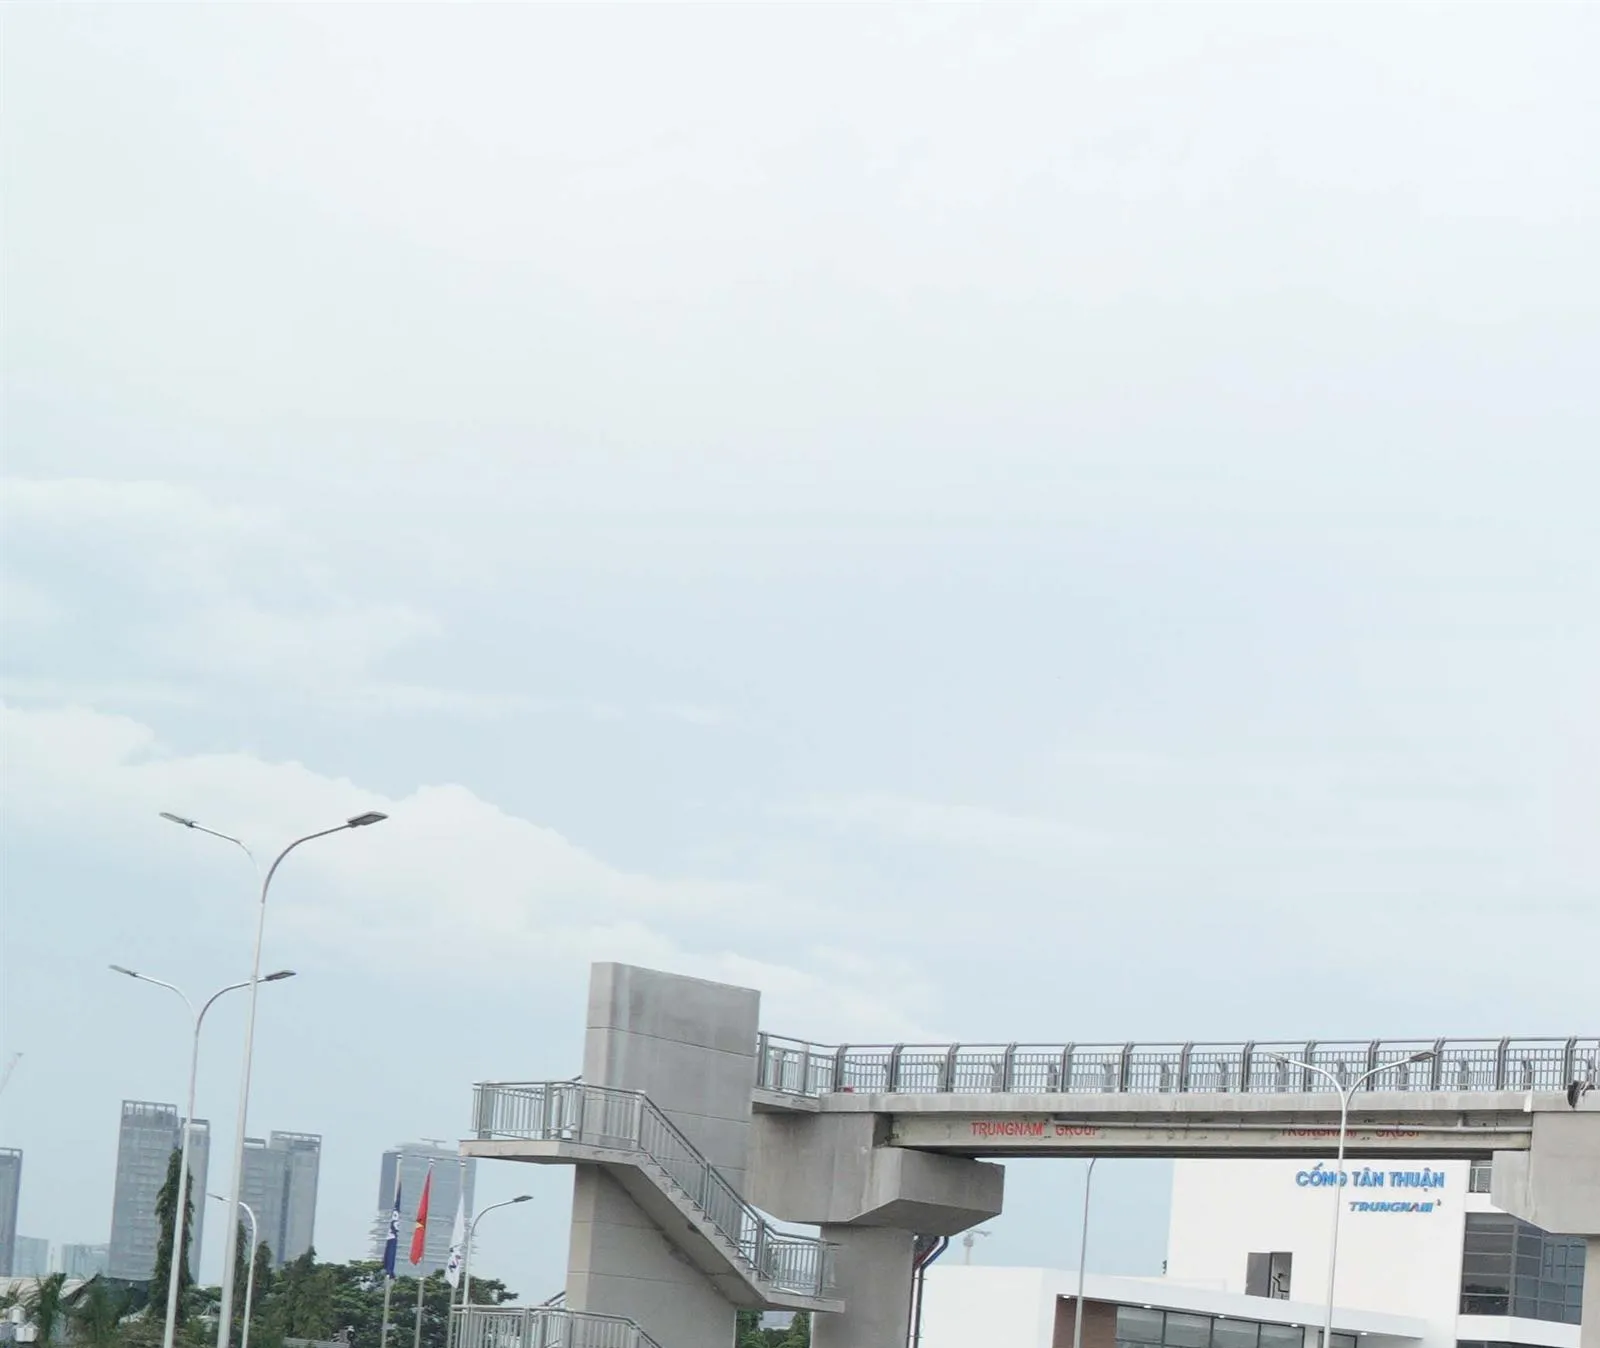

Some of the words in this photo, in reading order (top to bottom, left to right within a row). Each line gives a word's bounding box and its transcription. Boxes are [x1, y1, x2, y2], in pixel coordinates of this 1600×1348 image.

[971, 1121, 1044, 1136] TRUNGNAM
[1352, 1167, 1384, 1187] TÂN
[1388, 1167, 1444, 1192] THUẬN
[1349, 1201, 1434, 1213] TRUNGNAM
